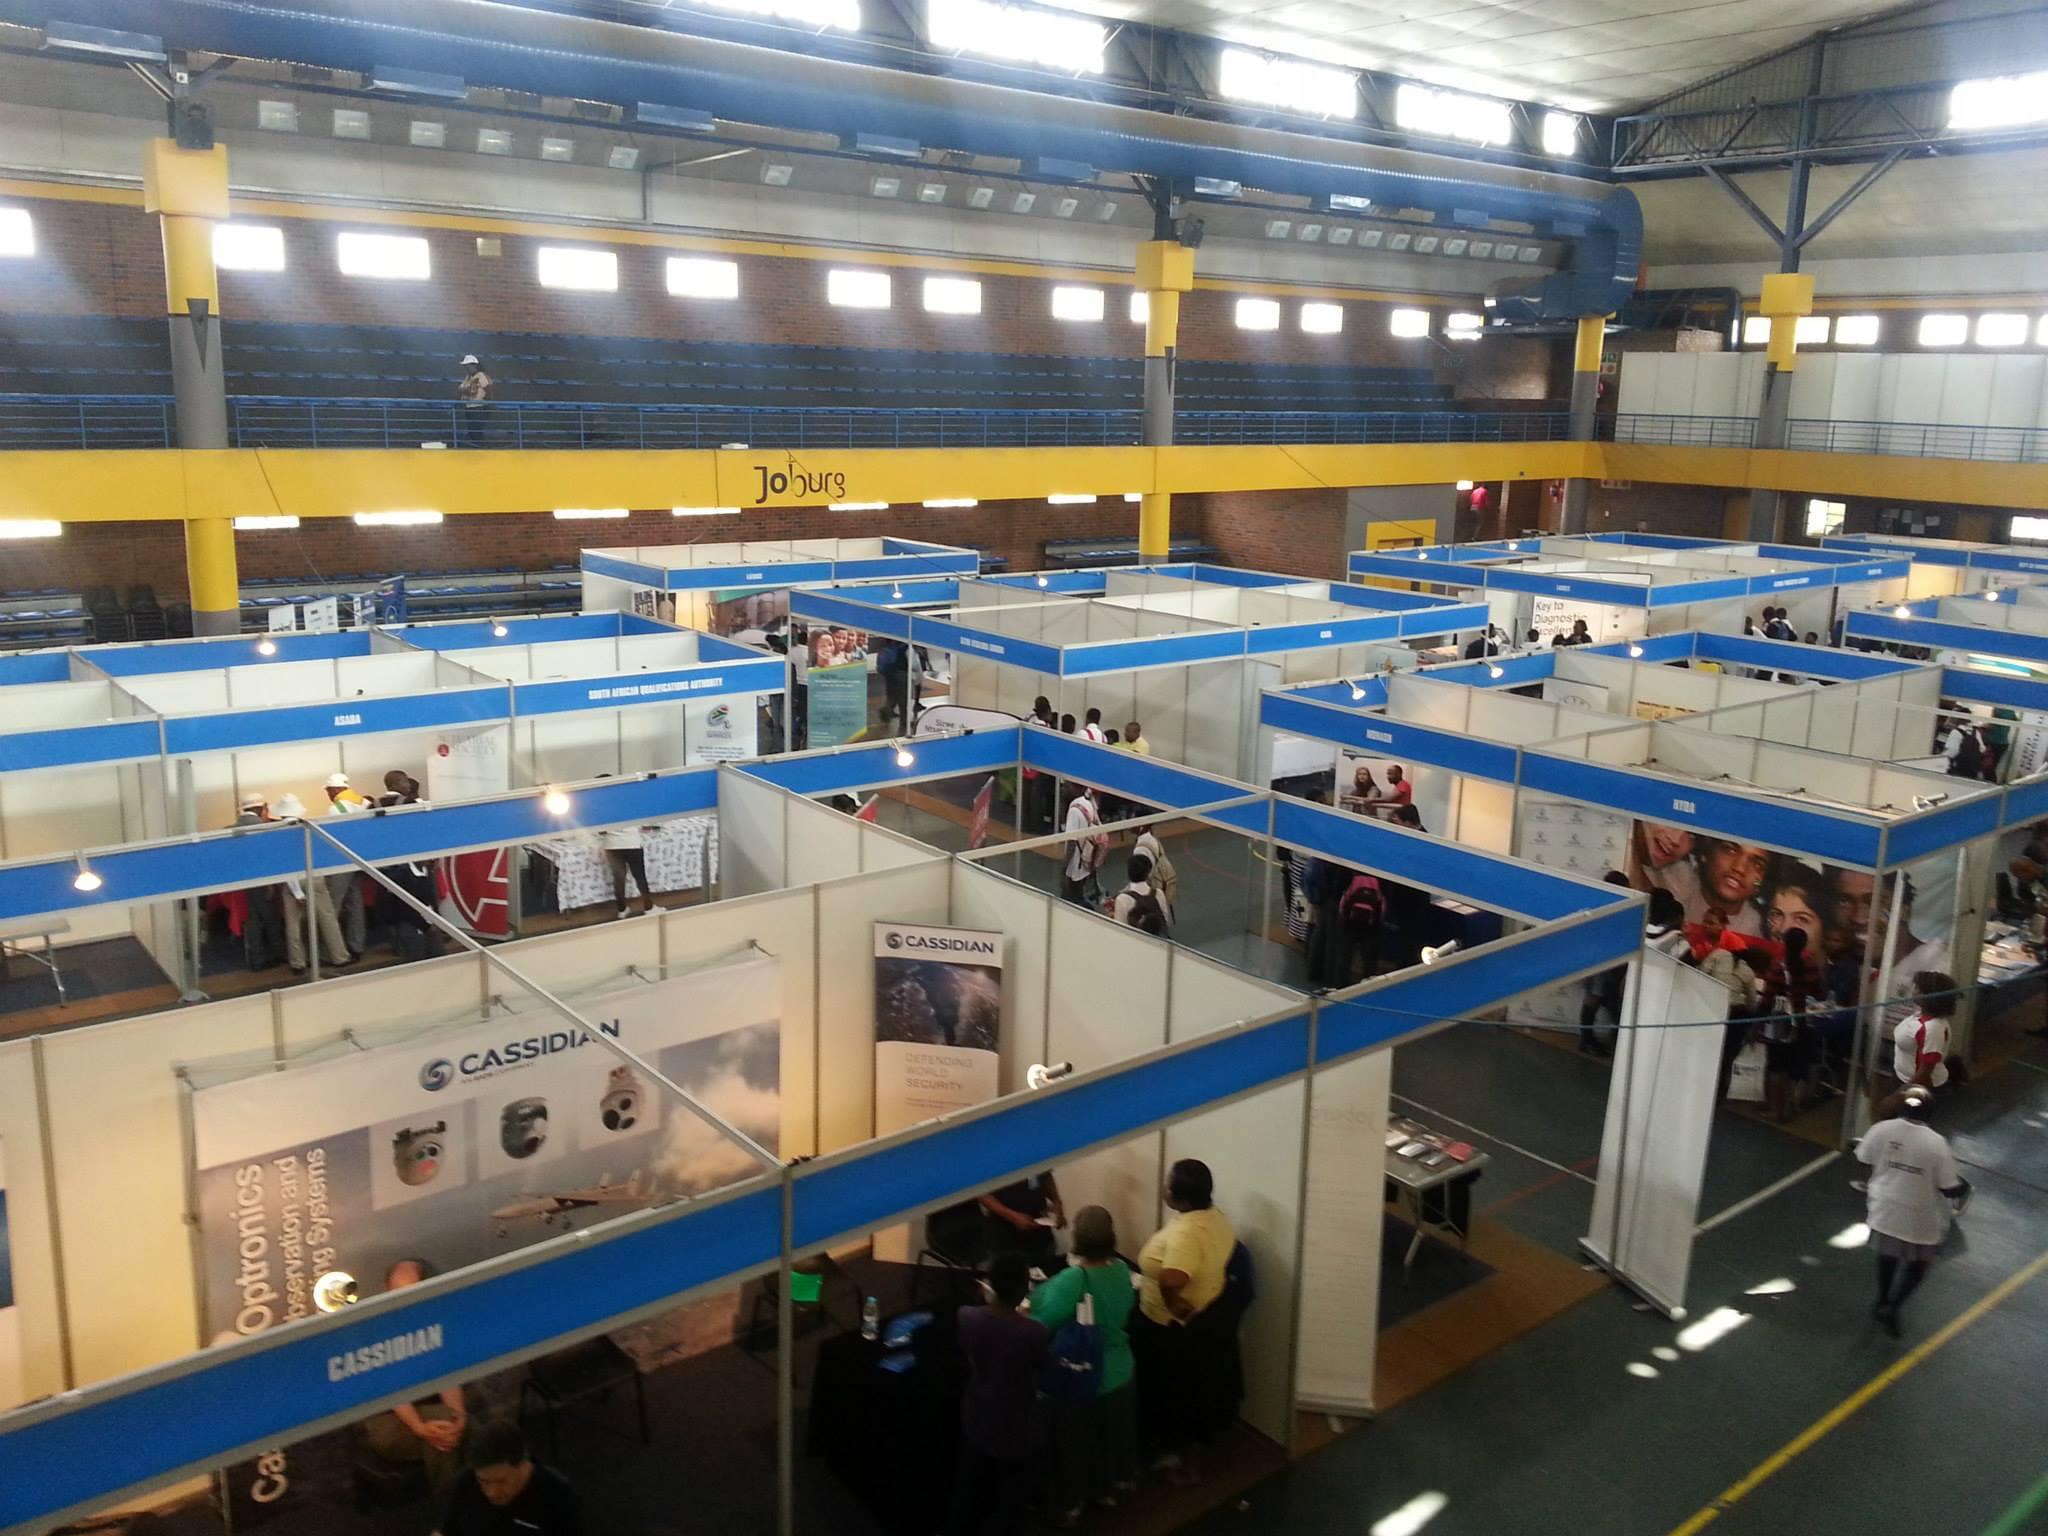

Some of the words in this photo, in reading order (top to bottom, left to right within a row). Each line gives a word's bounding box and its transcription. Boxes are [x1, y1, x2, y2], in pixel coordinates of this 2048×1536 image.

[753, 463, 846, 504] Joburg
[1535, 602, 1551, 612] Key
[1554, 601, 1564, 611] to
[905, 934, 995, 953] CASSIDIAN
[904, 1052, 974, 1068] DEFENDING
[905, 1066, 950, 1078] WORLD
[905, 1078, 962, 1090] SECURITY
[273, 1155, 299, 1200] and
[305, 1147, 335, 1246] Systems
[228, 1163, 280, 1336] Optronics
[276, 1203, 307, 1321] bservation
[328, 1323, 443, 1381] CASSIDIAN
